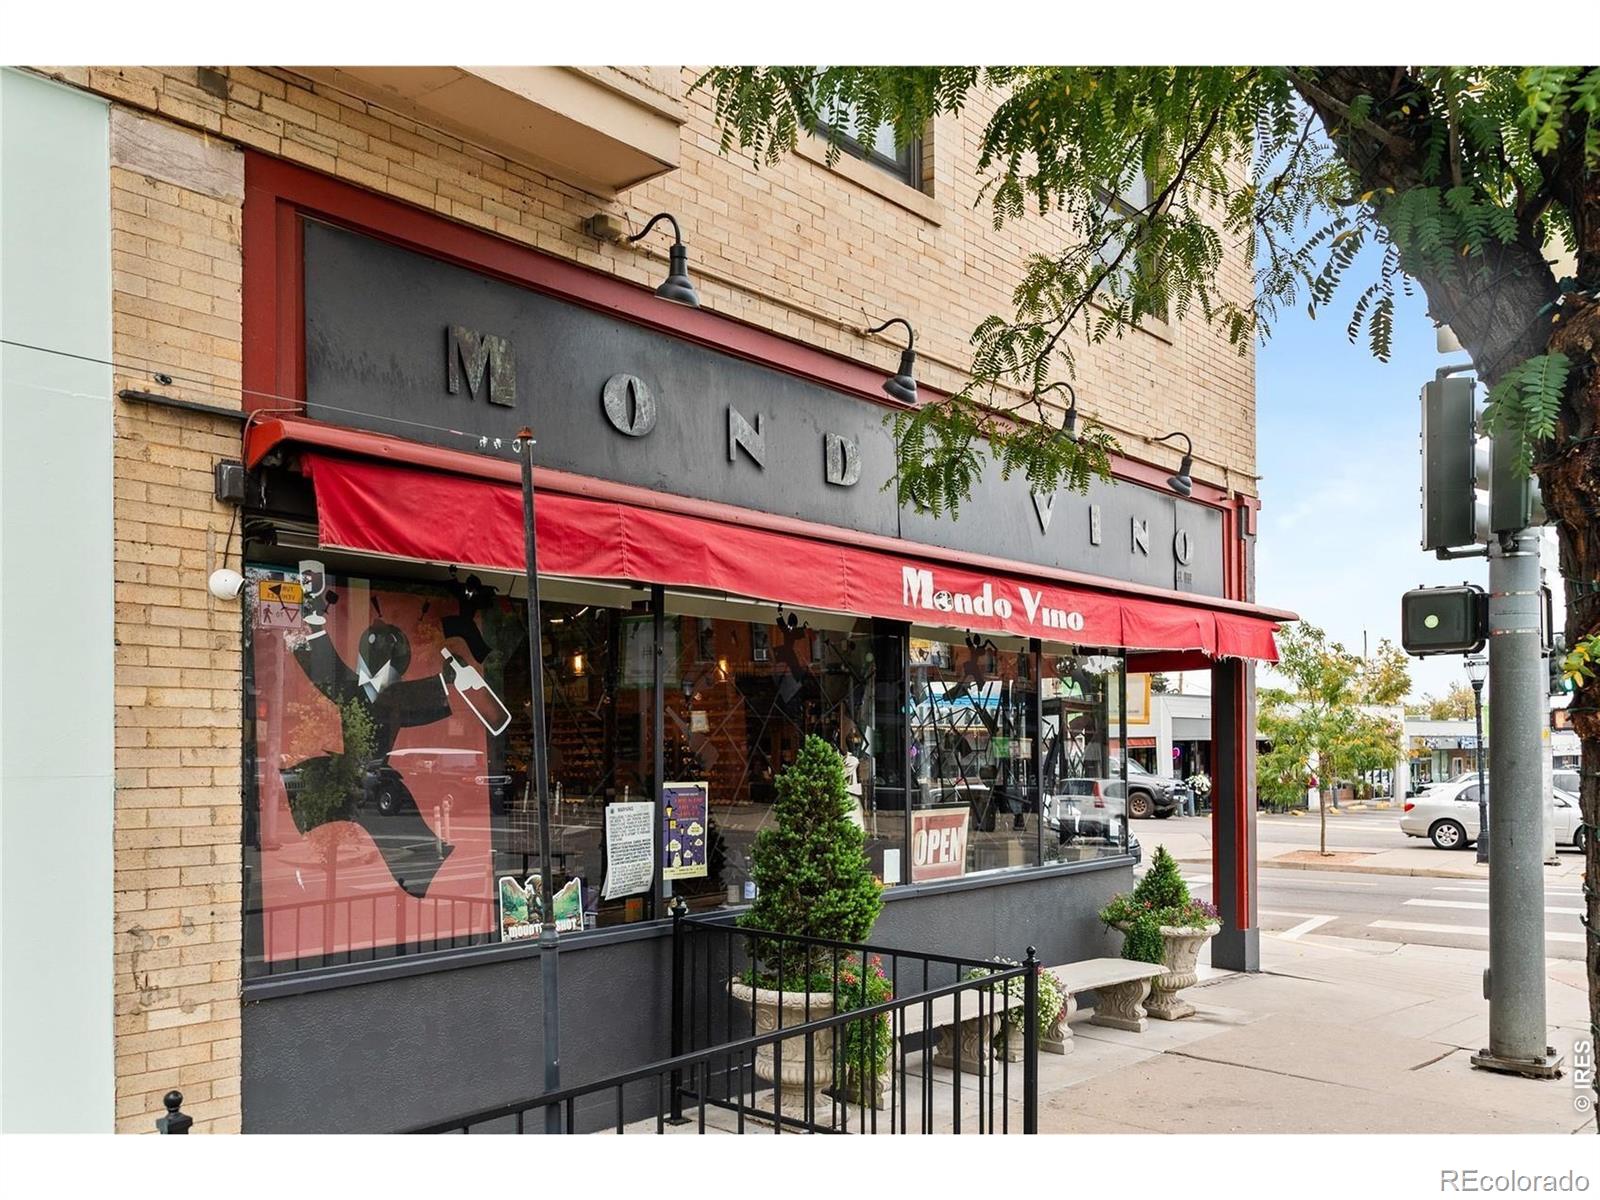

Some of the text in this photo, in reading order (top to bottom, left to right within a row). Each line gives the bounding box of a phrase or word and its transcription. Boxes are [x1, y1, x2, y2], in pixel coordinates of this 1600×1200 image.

[447, 325, 1193, 567] MOND VINO
[901, 565, 1085, 632] Mondo Vino
[914, 827, 963, 866] OPEN
